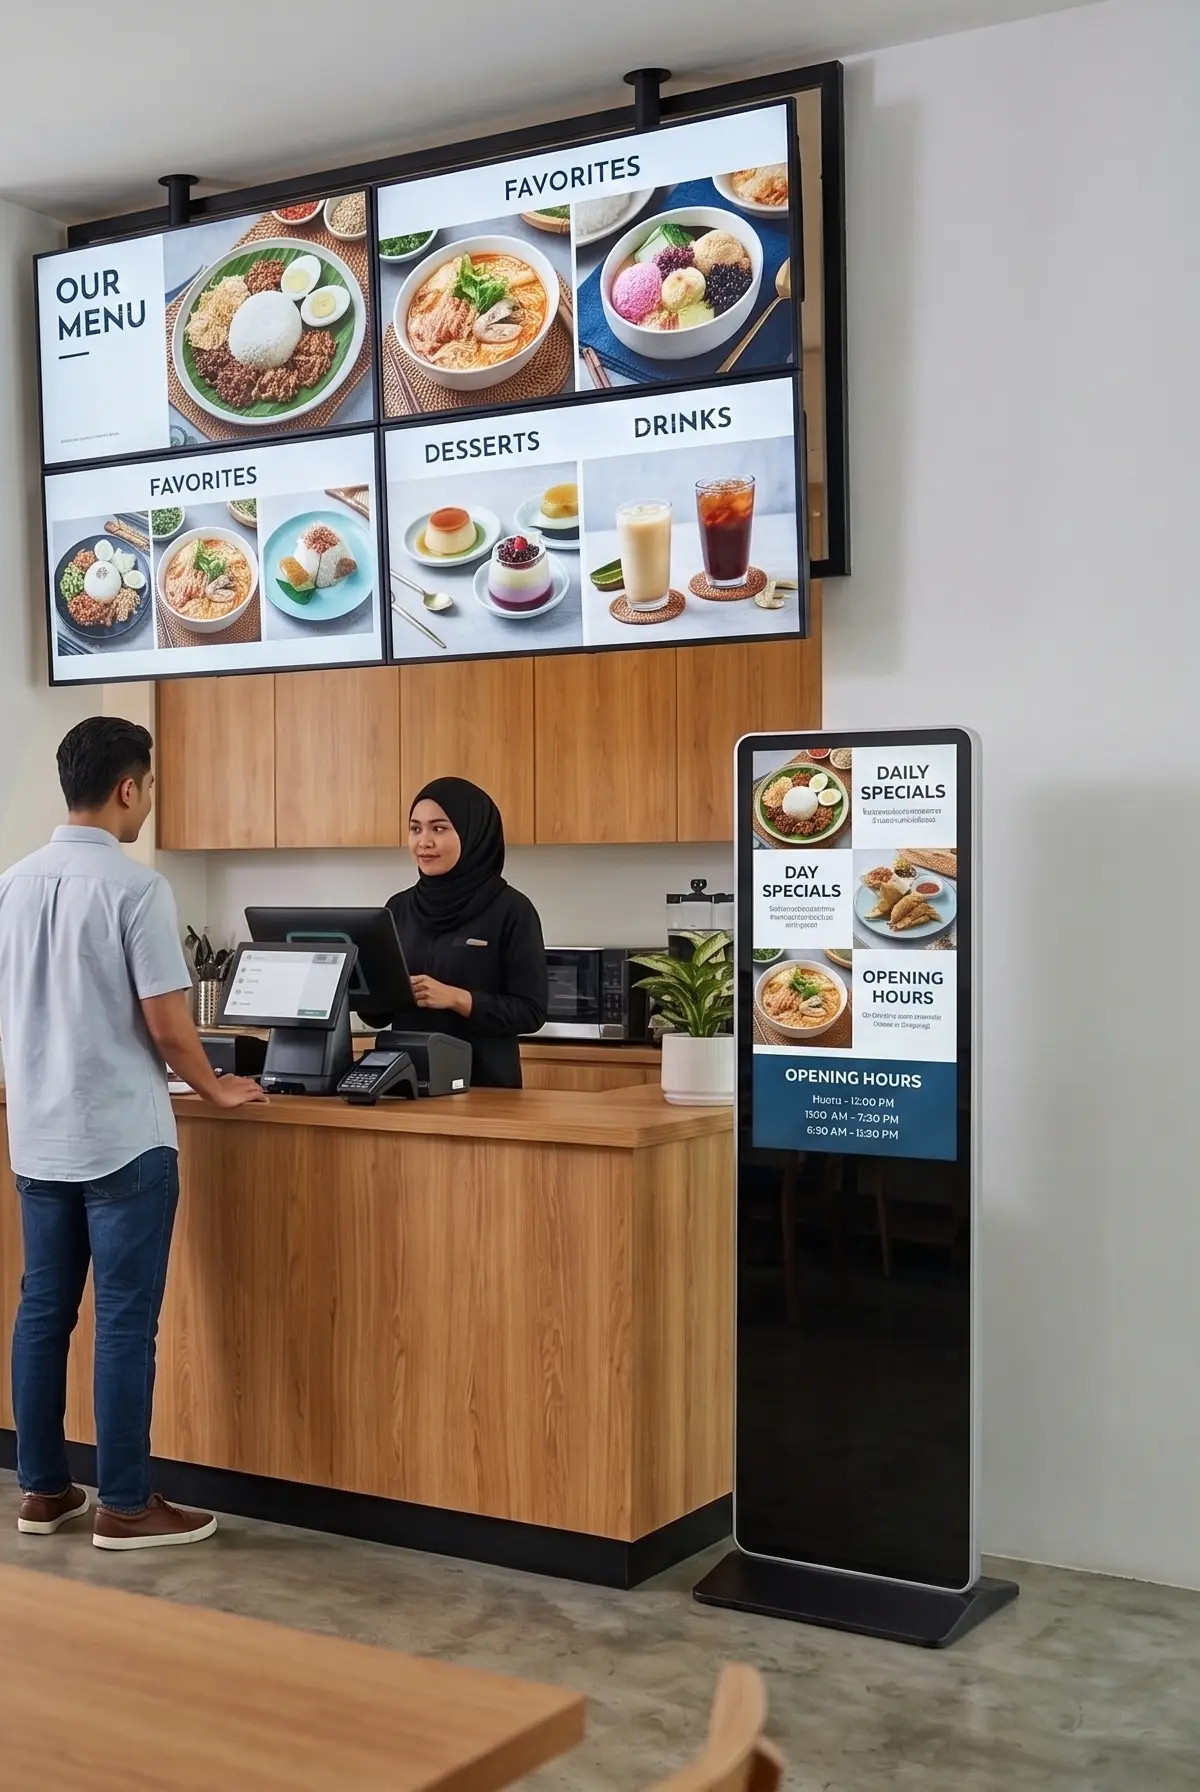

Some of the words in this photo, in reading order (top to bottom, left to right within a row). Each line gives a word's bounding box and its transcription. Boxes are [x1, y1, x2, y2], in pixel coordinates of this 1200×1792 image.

[505, 155, 641, 201] FAVORITES
[56, 269, 120, 304] OUR
[58, 300, 146, 341] MENU
[634, 406, 732, 438] DRINKS
[425, 431, 540, 463] DESSERTS
[150, 466, 257, 496] FAVORITES
[877, 764, 929, 780] DAILY
[861, 784, 946, 800] SPECIALS
[785, 866, 819, 879] DAY
[762, 884, 841, 898] SPECIALS
[862, 970, 944, 985] OPENING
[872, 990, 934, 1005] HOURS
[785, 1068, 859, 1085] OPENING
[863, 1072, 922, 1088] HOURS
[878, 1098, 895, 1108] PM
[831, 1111, 848, 1121] AM
[857, 1113, 880, 1123] 7:30
[883, 1114, 899, 1124] PM
[830, 1127, 847, 1137] AM
[882, 1130, 899, 1140] PM
